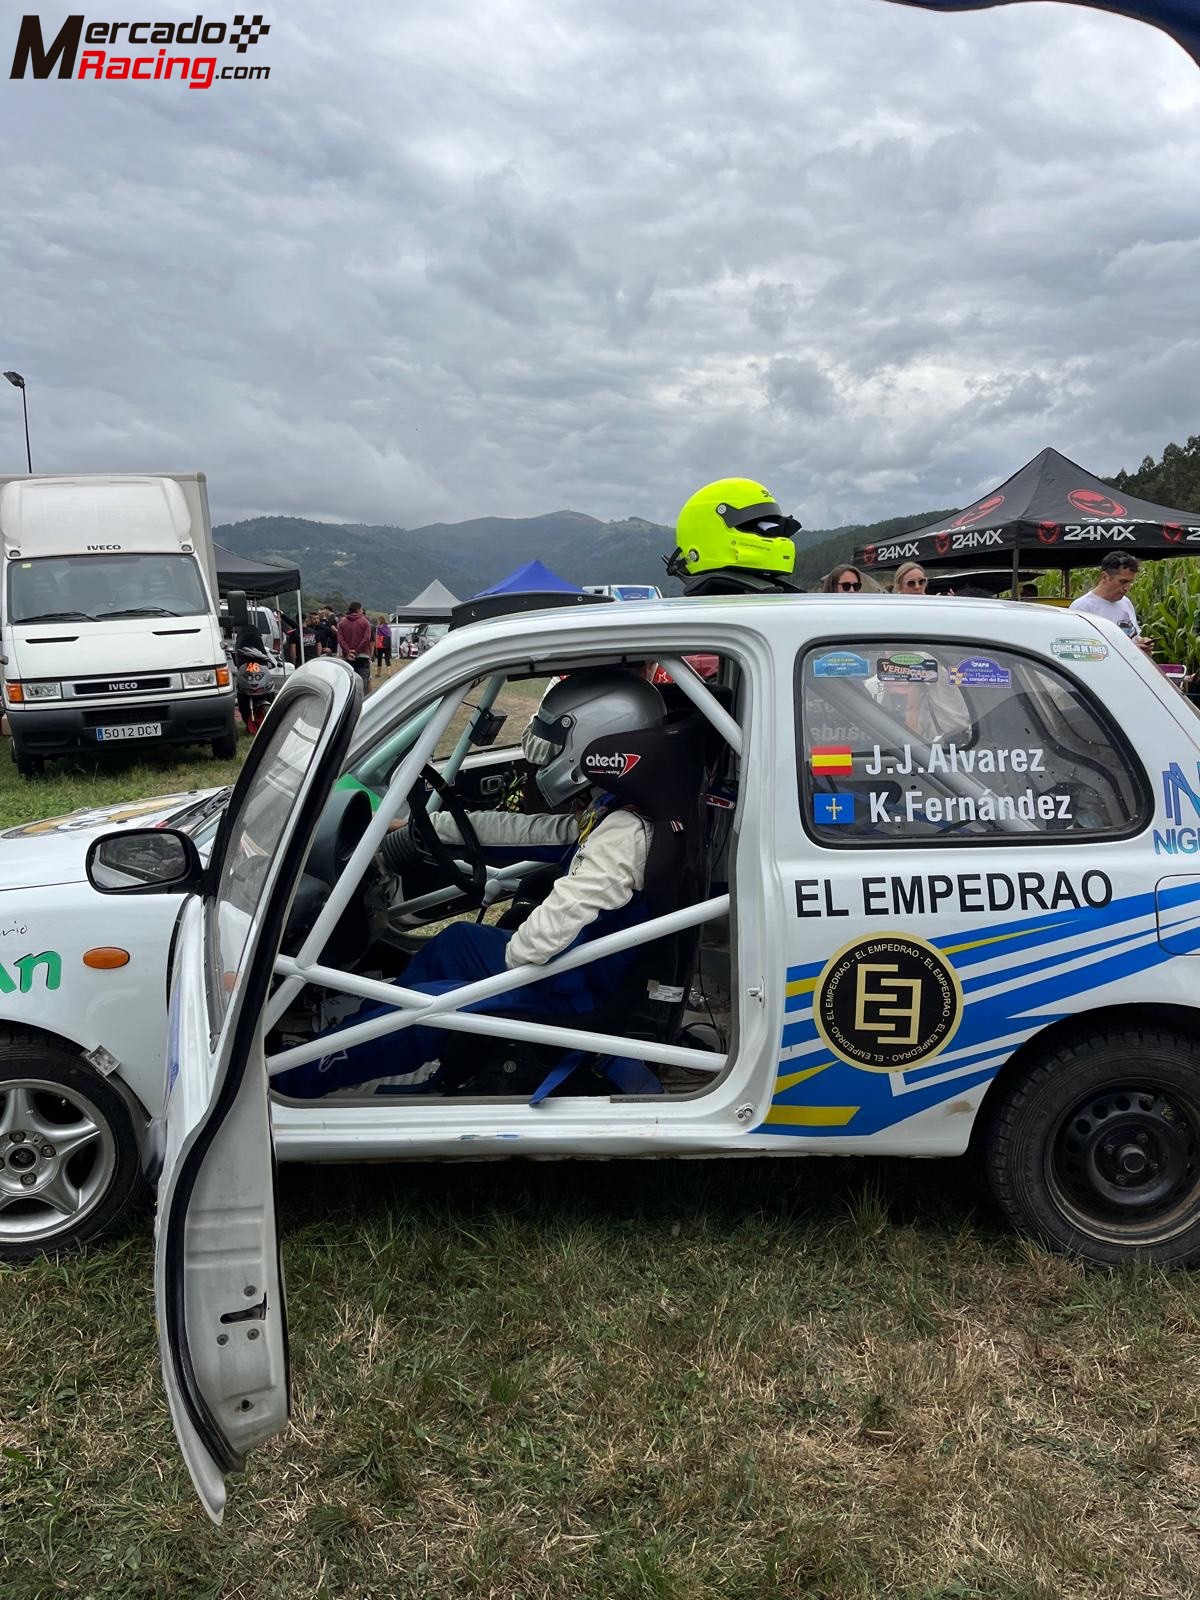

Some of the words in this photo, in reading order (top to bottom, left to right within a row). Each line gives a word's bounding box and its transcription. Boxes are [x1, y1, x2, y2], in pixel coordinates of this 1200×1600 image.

[952, 528, 1003, 550] 24MX
[1063, 525, 1136, 541] 24MX
[878, 542, 920, 561] 24MX
[246, 662, 261, 673] 46
[108, 682, 138, 691] IVECO
[104, 724, 135, 738] 5012
[137, 724, 160, 736] DCY
[586, 752, 625, 768] atech
[870, 788, 1073, 823] K.Fernández
[1153, 827, 1200, 854] NIG
[795, 878, 849, 919] EL
[861, 869, 1113, 916] EMPEDRAO
[855, 951, 866, 959] EL
[868, 944, 919, 958] EMPEDRAO
[826, 961, 850, 1008] EMPEDRAO
[924, 958, 933, 970] EL
[933, 968, 952, 1017] EMPEDRAO
[827, 1010, 834, 1020] EL
[934, 1023, 946, 1032] EL
[832, 1028, 870, 1061] EMPEDRAO
[892, 1034, 939, 1062] EMPEDRAO
[873, 1054, 884, 1062] EL
